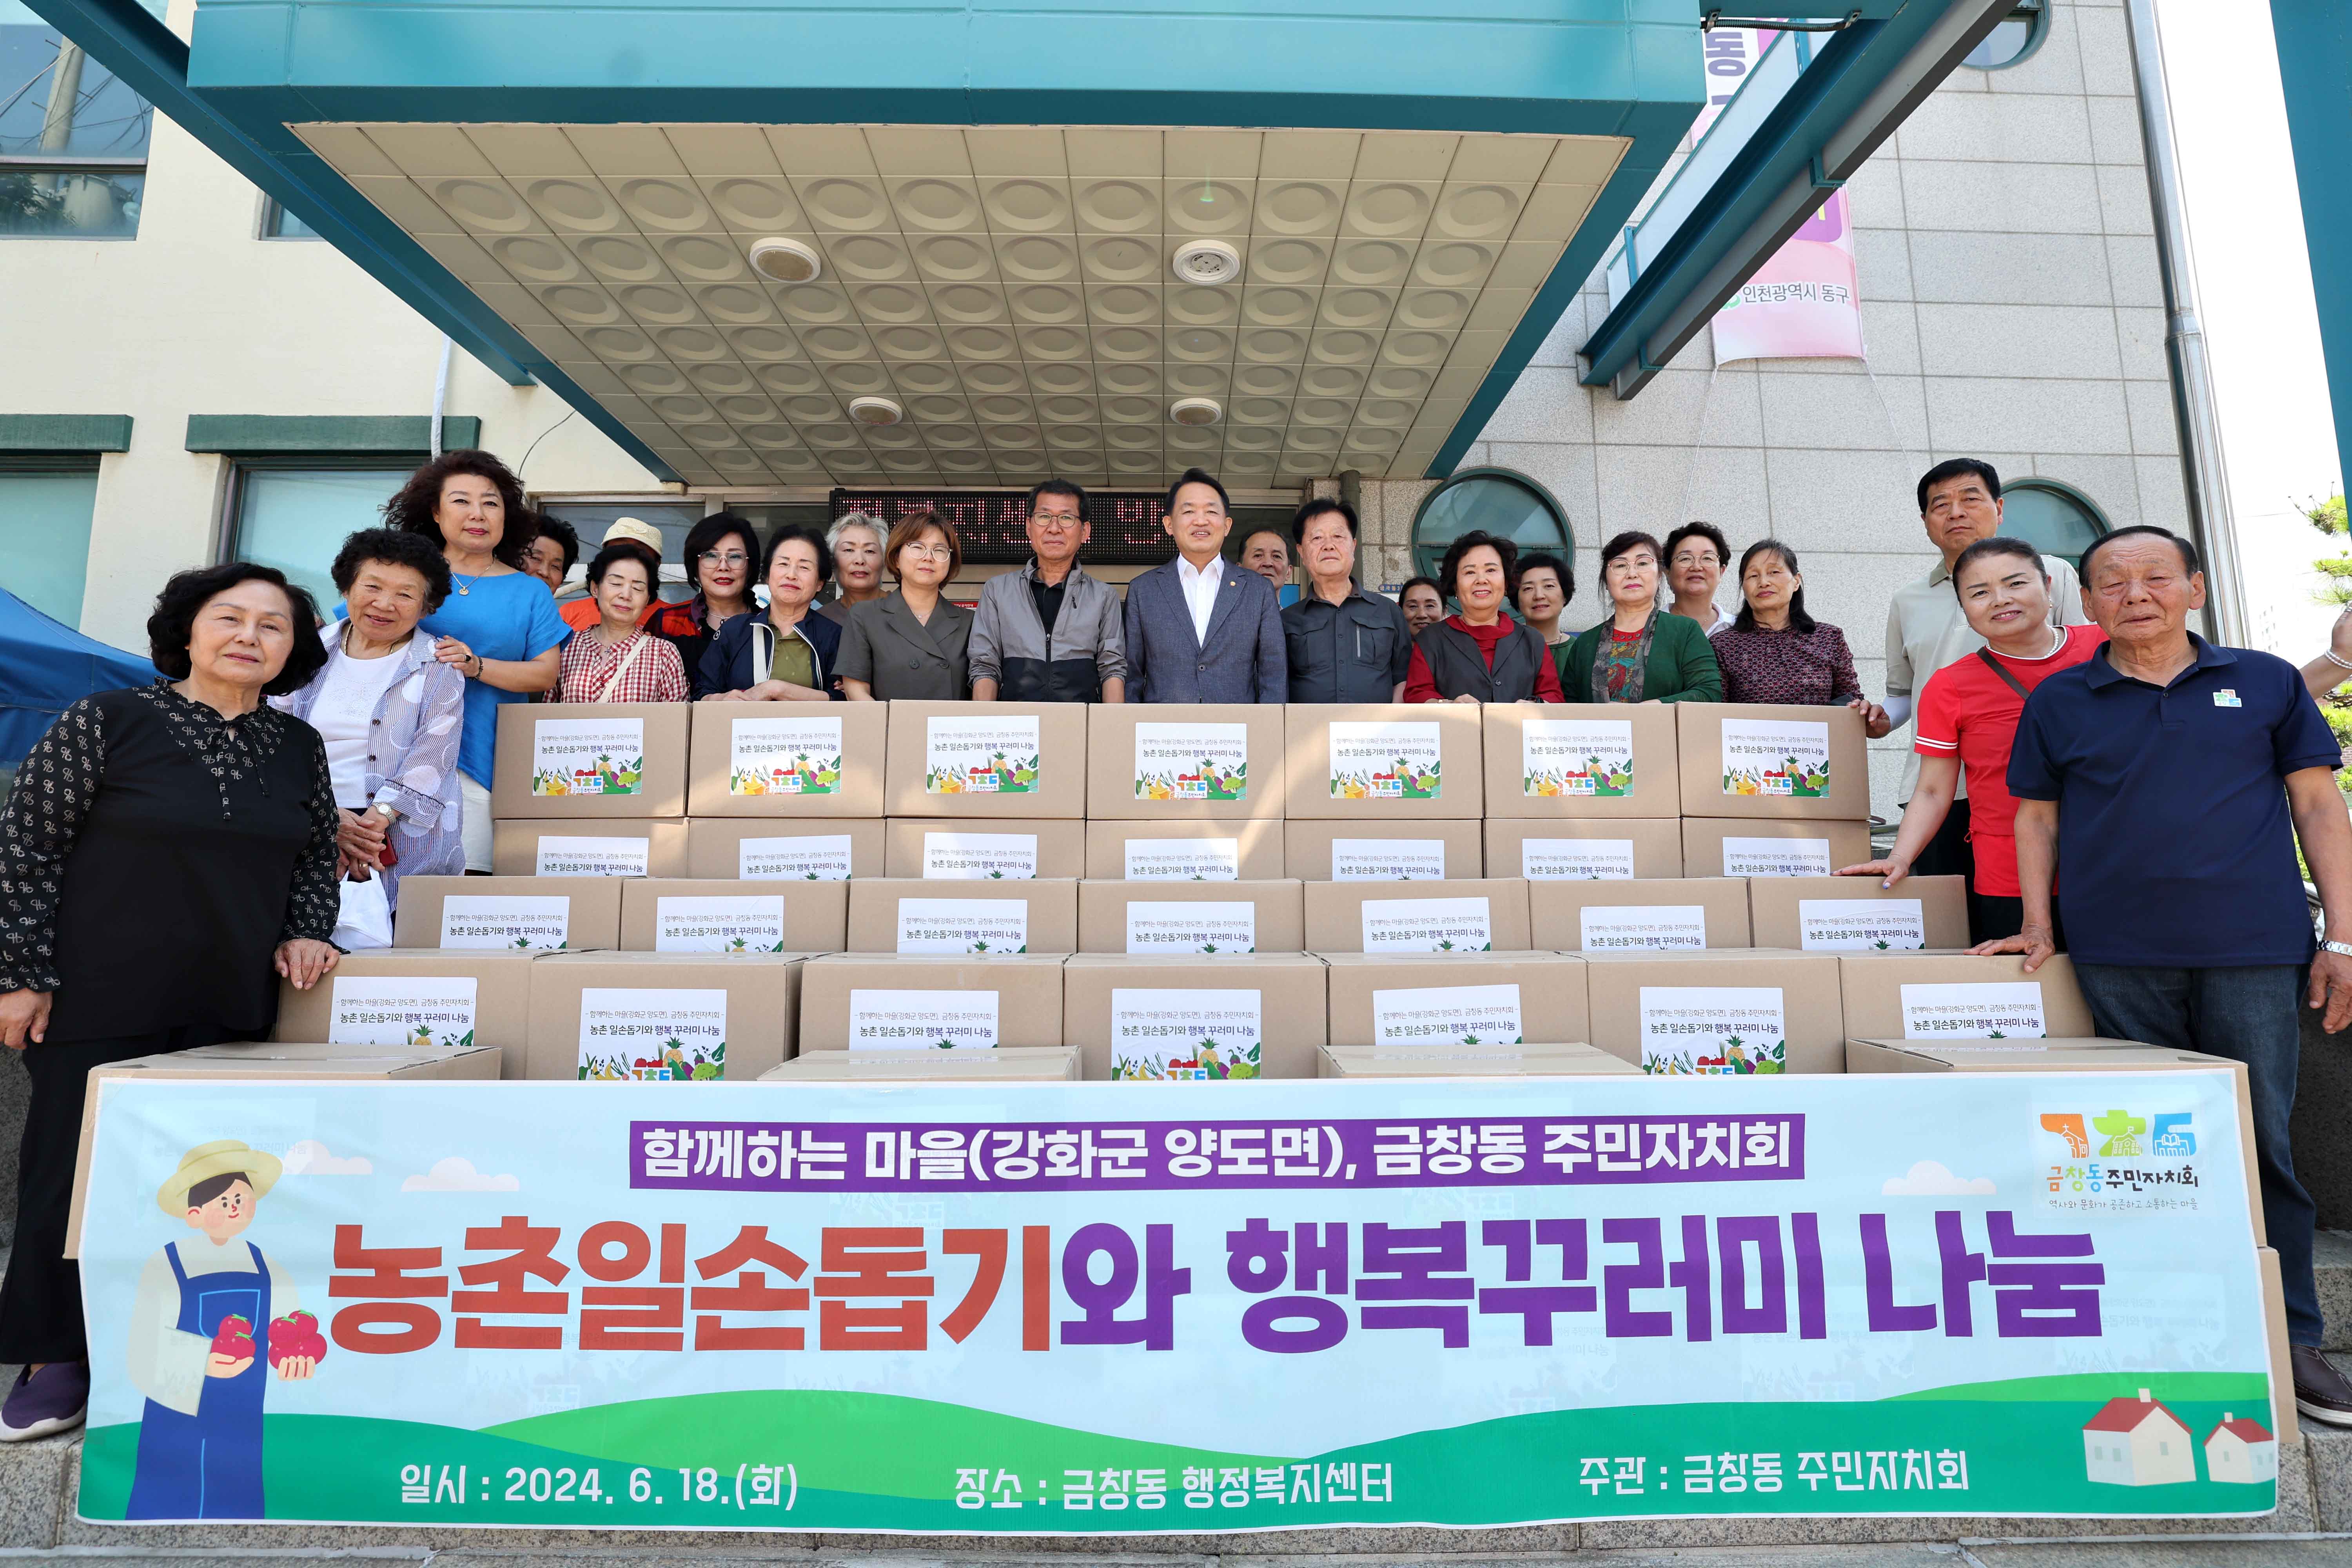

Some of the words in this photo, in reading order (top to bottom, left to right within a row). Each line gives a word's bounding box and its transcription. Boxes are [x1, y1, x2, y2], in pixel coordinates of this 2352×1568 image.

[1743, 283, 1817, 303] 인천광역시
[1821, 284, 1850, 304] 동구
[541, 746, 555, 755] 농촌
[556, 745, 590, 754] 일손돕기와
[590, 745, 604, 755] 행복
[604, 744, 624, 755] 꾸러미
[625, 744, 639, 752] 나눔
[738, 744, 753, 753] 농촌
[753, 744, 787, 753] 일손돕기와
[787, 744, 802, 754] 행복
[802, 743, 822, 754] 꾸러미
[823, 743, 837, 751] 나눔
[934, 743, 949, 751] 농촌
[949, 742, 984, 751] 일손돕기와
[984, 742, 998, 751] 행복
[998, 742, 1019, 750] 꾸러미
[1020, 742, 1035, 750] 나눔
[1530, 746, 1544, 755] 농촌
[1545, 746, 1578, 755] 일손돕기와
[1579, 746, 1593, 756] 행복
[1593, 746, 1613, 756] 꾸러미
[1614, 746, 1628, 755] 나눔
[1729, 745, 1743, 753] 농촌
[1743, 745, 1777, 754] 일손돕기와
[1776, 746, 1790, 756] 행복
[1791, 747, 1811, 757] 꾸러미
[1811, 747, 1825, 756] 나눔
[1142, 749, 1157, 757] 농촌
[1157, 749, 1192, 757] 일손돕기와
[1192, 749, 1206, 759] 행복
[1207, 750, 1227, 759] 꾸러미
[1229, 750, 1242, 758] 나눔
[1337, 748, 1351, 757] 농촌
[1352, 748, 1386, 757] 일손돕기와
[1386, 748, 1401, 758] 행복
[1401, 748, 1421, 758] 꾸러미
[1422, 748, 1437, 757] 나눔
[543, 862, 558, 871] 농촌
[558, 863, 593, 872] 일손돕기와
[593, 864, 607, 874] 행복
[608, 864, 628, 874] 꾸러미
[629, 864, 643, 873] 나눔
[1339, 866, 1354, 875] 농촌
[1354, 866, 1389, 875] 일손돕기와
[1389, 866, 1404, 875] 행복
[1404, 866, 1425, 875] 꾸러미
[1426, 866, 1440, 875] 나눔
[449, 926, 465, 936] 농촌
[466, 926, 505, 936] 일손돕기와
[506, 926, 522, 938] 행복
[523, 926, 546, 938] 꾸러미
[547, 927, 563, 936] 나눔
[906, 929, 922, 939] 농촌
[923, 929, 963, 940] 일손돕기와
[963, 930, 980, 941] 행복
[980, 930, 1004, 941] 꾸러미
[1005, 930, 1022, 940] 나눔
[1371, 931, 1387, 941] 농촌
[1388, 930, 1427, 940] 일손돕기와
[1427, 929, 1444, 940] 행복
[1445, 928, 1468, 940] 꾸러미
[1469, 928, 1486, 938] 나눔
[1809, 930, 1825, 940] 농촌
[1825, 930, 1864, 940] 일손돕기와
[1863, 929, 1880, 940] 행복
[1880, 929, 1903, 940] 꾸러미
[1904, 929, 1919, 938] 나눔
[339, 1012, 358, 1024] 농촌
[359, 1012, 403, 1024] 일손돕기와
[404, 1013, 422, 1025] 행복
[423, 1012, 450, 1025] 꾸러미
[451, 1013, 470, 1024] 나눔
[1913, 1020, 1931, 1031] 농촌
[1931, 1018, 1975, 1031] 일손돕기와
[1975, 1018, 1994, 1031] 행복
[1994, 1017, 2020, 1031] 꾸러미
[2022, 1017, 2040, 1028] 나눔
[590, 1024, 608, 1036] 농촌
[609, 1024, 653, 1036] 일손돕기와
[654, 1025, 673, 1038] 행복
[674, 1025, 701, 1038] 꾸러미
[702, 1025, 721, 1036] 나눔
[859, 1025, 878, 1037] 농촌
[879, 1026, 925, 1037] 일손돕기와
[925, 1026, 944, 1039] 행복
[945, 1027, 972, 1039] 꾸러미
[974, 1027, 993, 1038] 나눔
[1121, 1025, 1140, 1036] 농촌
[1141, 1025, 1187, 1036] 일손돕기와
[1188, 1025, 1207, 1038] 행복
[1207, 1025, 1234, 1038] 꾸러미
[1236, 1025, 1255, 1036] 나눔
[1384, 1025, 1403, 1038] 농촌
[1404, 1023, 1449, 1036] 일손돕기와
[1449, 1022, 1468, 1035] 행복
[1469, 1021, 1496, 1035] 꾸러미
[1497, 1020, 1516, 1031] 나눔
[1650, 1023, 1668, 1034] 농촌
[1669, 1023, 1713, 1034] 일손돕기와
[1714, 1023, 1732, 1034] 행복
[1733, 1023, 1759, 1034] 꾸러미
[1761, 1023, 1779, 1034] 나눔
[643, 1129, 847, 1180] 함께하는
[865, 1129, 1148, 1181] 마을(강화군
[1165, 1126, 1357, 1180] 양도면),
[1374, 1125, 1524, 1176] 금창동
[1543, 1122, 1791, 1172] 주민자치회
[2049, 1200, 2077, 1209] 역사와
[2080, 1199, 2107, 1210] 문화가
[2110, 1198, 2142, 1210] 공존하고
[2145, 1198, 2178, 1210] 소통하는
[2180, 1198, 2199, 1210] 마을
[328, 1216, 1191, 1354] 농촌일손돕기와
[1858, 1210, 2105, 1338] 나눔
[1579, 1456, 1646, 1496] 주관
[1684, 1452, 1783, 1494] 금창동
[1797, 1448, 1969, 1492] 주민자치회
[400, 1465, 466, 1504] 일시
[505, 1467, 613, 1504] 2024.
[629, 1467, 663, 1504] 6.
[679, 1463, 797, 1511] 18.(화)
[955, 1468, 1022, 1509] 장소
[1063, 1467, 1167, 1510] 금창동
[1182, 1463, 1392, 1508] 행정복지센터
